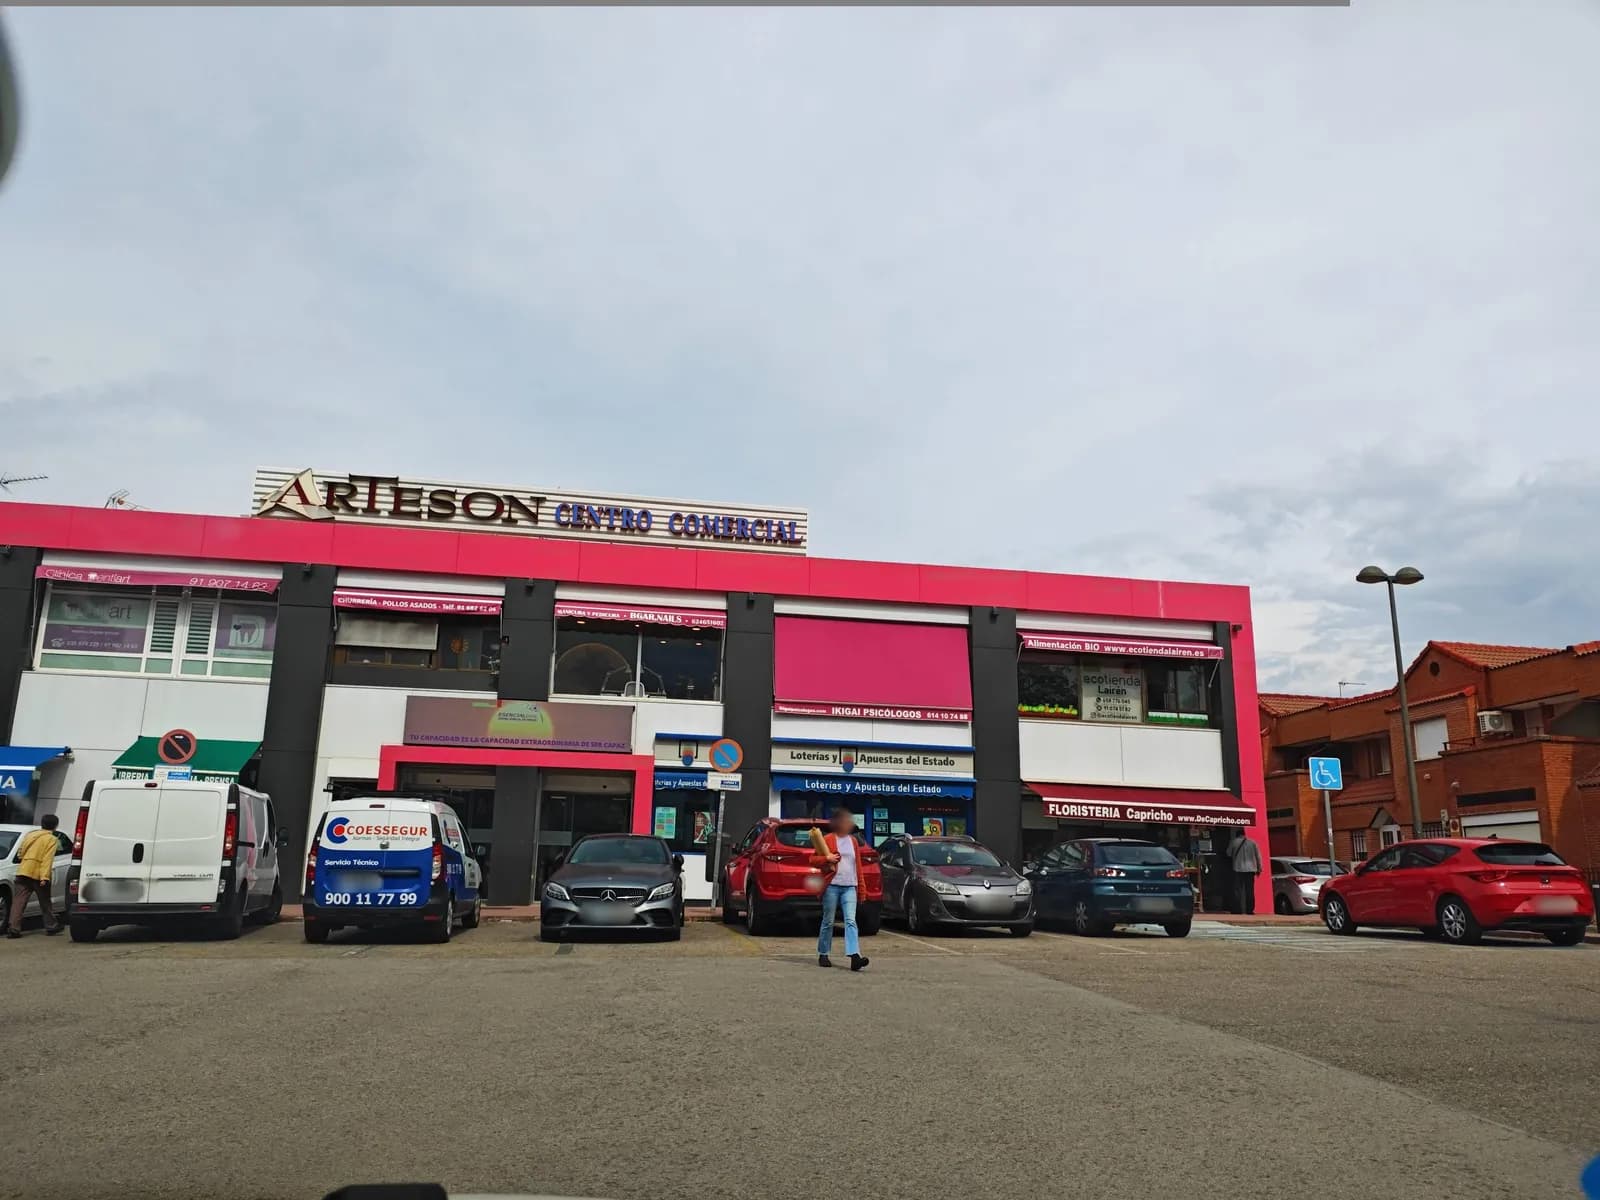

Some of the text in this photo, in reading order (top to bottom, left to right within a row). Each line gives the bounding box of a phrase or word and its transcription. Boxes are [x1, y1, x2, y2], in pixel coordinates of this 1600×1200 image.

[266, 472, 546, 525] ARTESON
[555, 502, 804, 543] CENTRO COMERCIAL
[208, 578, 231, 588] 907
[382, 600, 409, 608] POLLOS
[409, 602, 437, 610] ASADOS
[1028, 640, 1082, 651] Alimentación
[1084, 642, 1100, 652] BIO
[1083, 674, 1141, 687] ecotienda
[831, 707, 861, 716] IKIGAI
[863, 708, 922, 719] PSICÓLOGOS
[480, 737, 520, 745] CAPACIDAD
[790, 751, 955, 767] Loterías y Apuestas del Estado
[805, 780, 942, 794] Loterías y Apuestas del Estado
[1048, 803, 1121, 819] FLORISTERIA
[1126, 807, 1173, 823] Capricho
[346, 825, 428, 837] COESSEGUR
[353, 858, 379, 866] Técnico
[325, 892, 417, 905] 900 11 77 99
